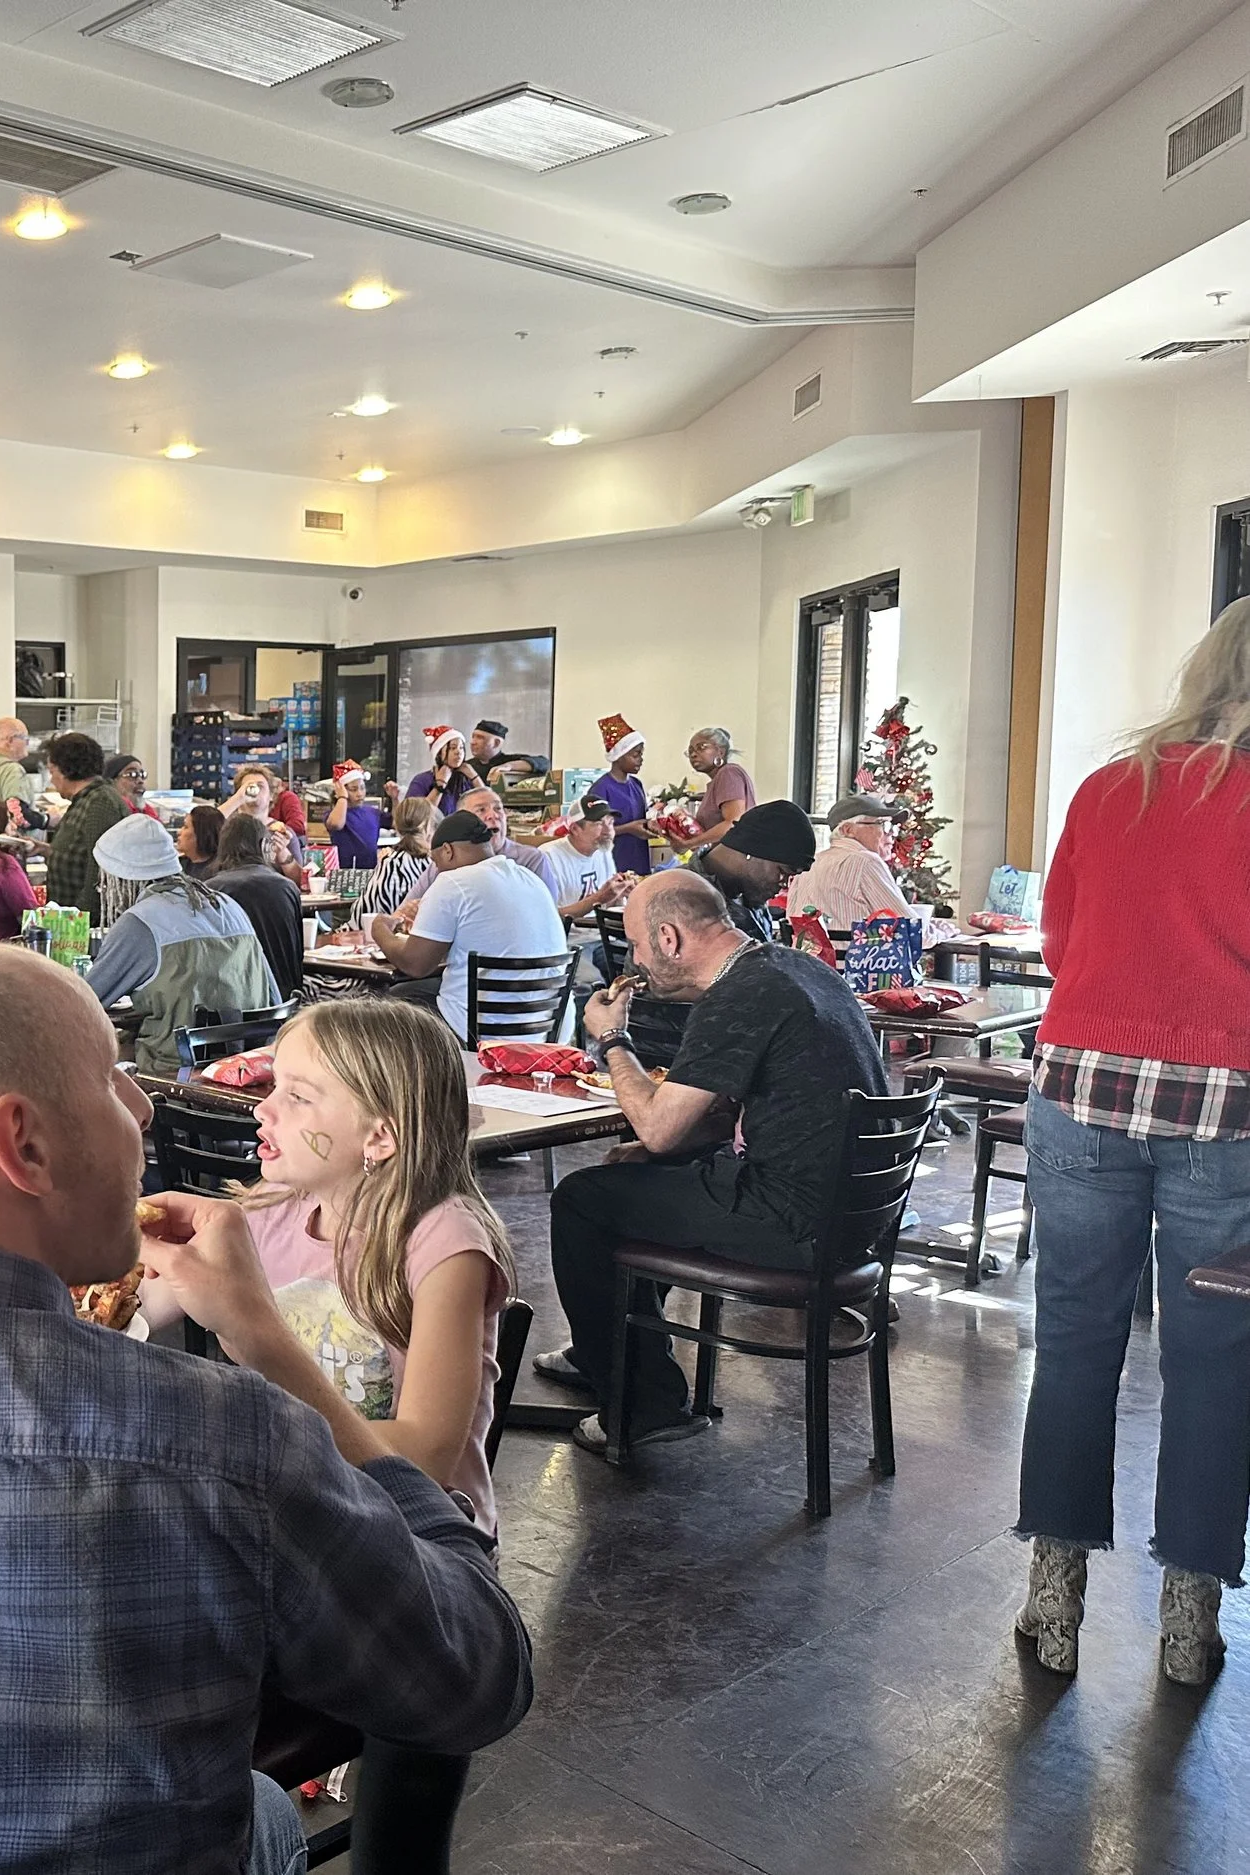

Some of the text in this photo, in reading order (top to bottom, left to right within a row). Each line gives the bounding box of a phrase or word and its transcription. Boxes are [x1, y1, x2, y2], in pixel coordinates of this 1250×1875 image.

[53, 937, 86, 952] oliday
[849, 946, 900, 971] what
[867, 973, 902, 991] FUN
